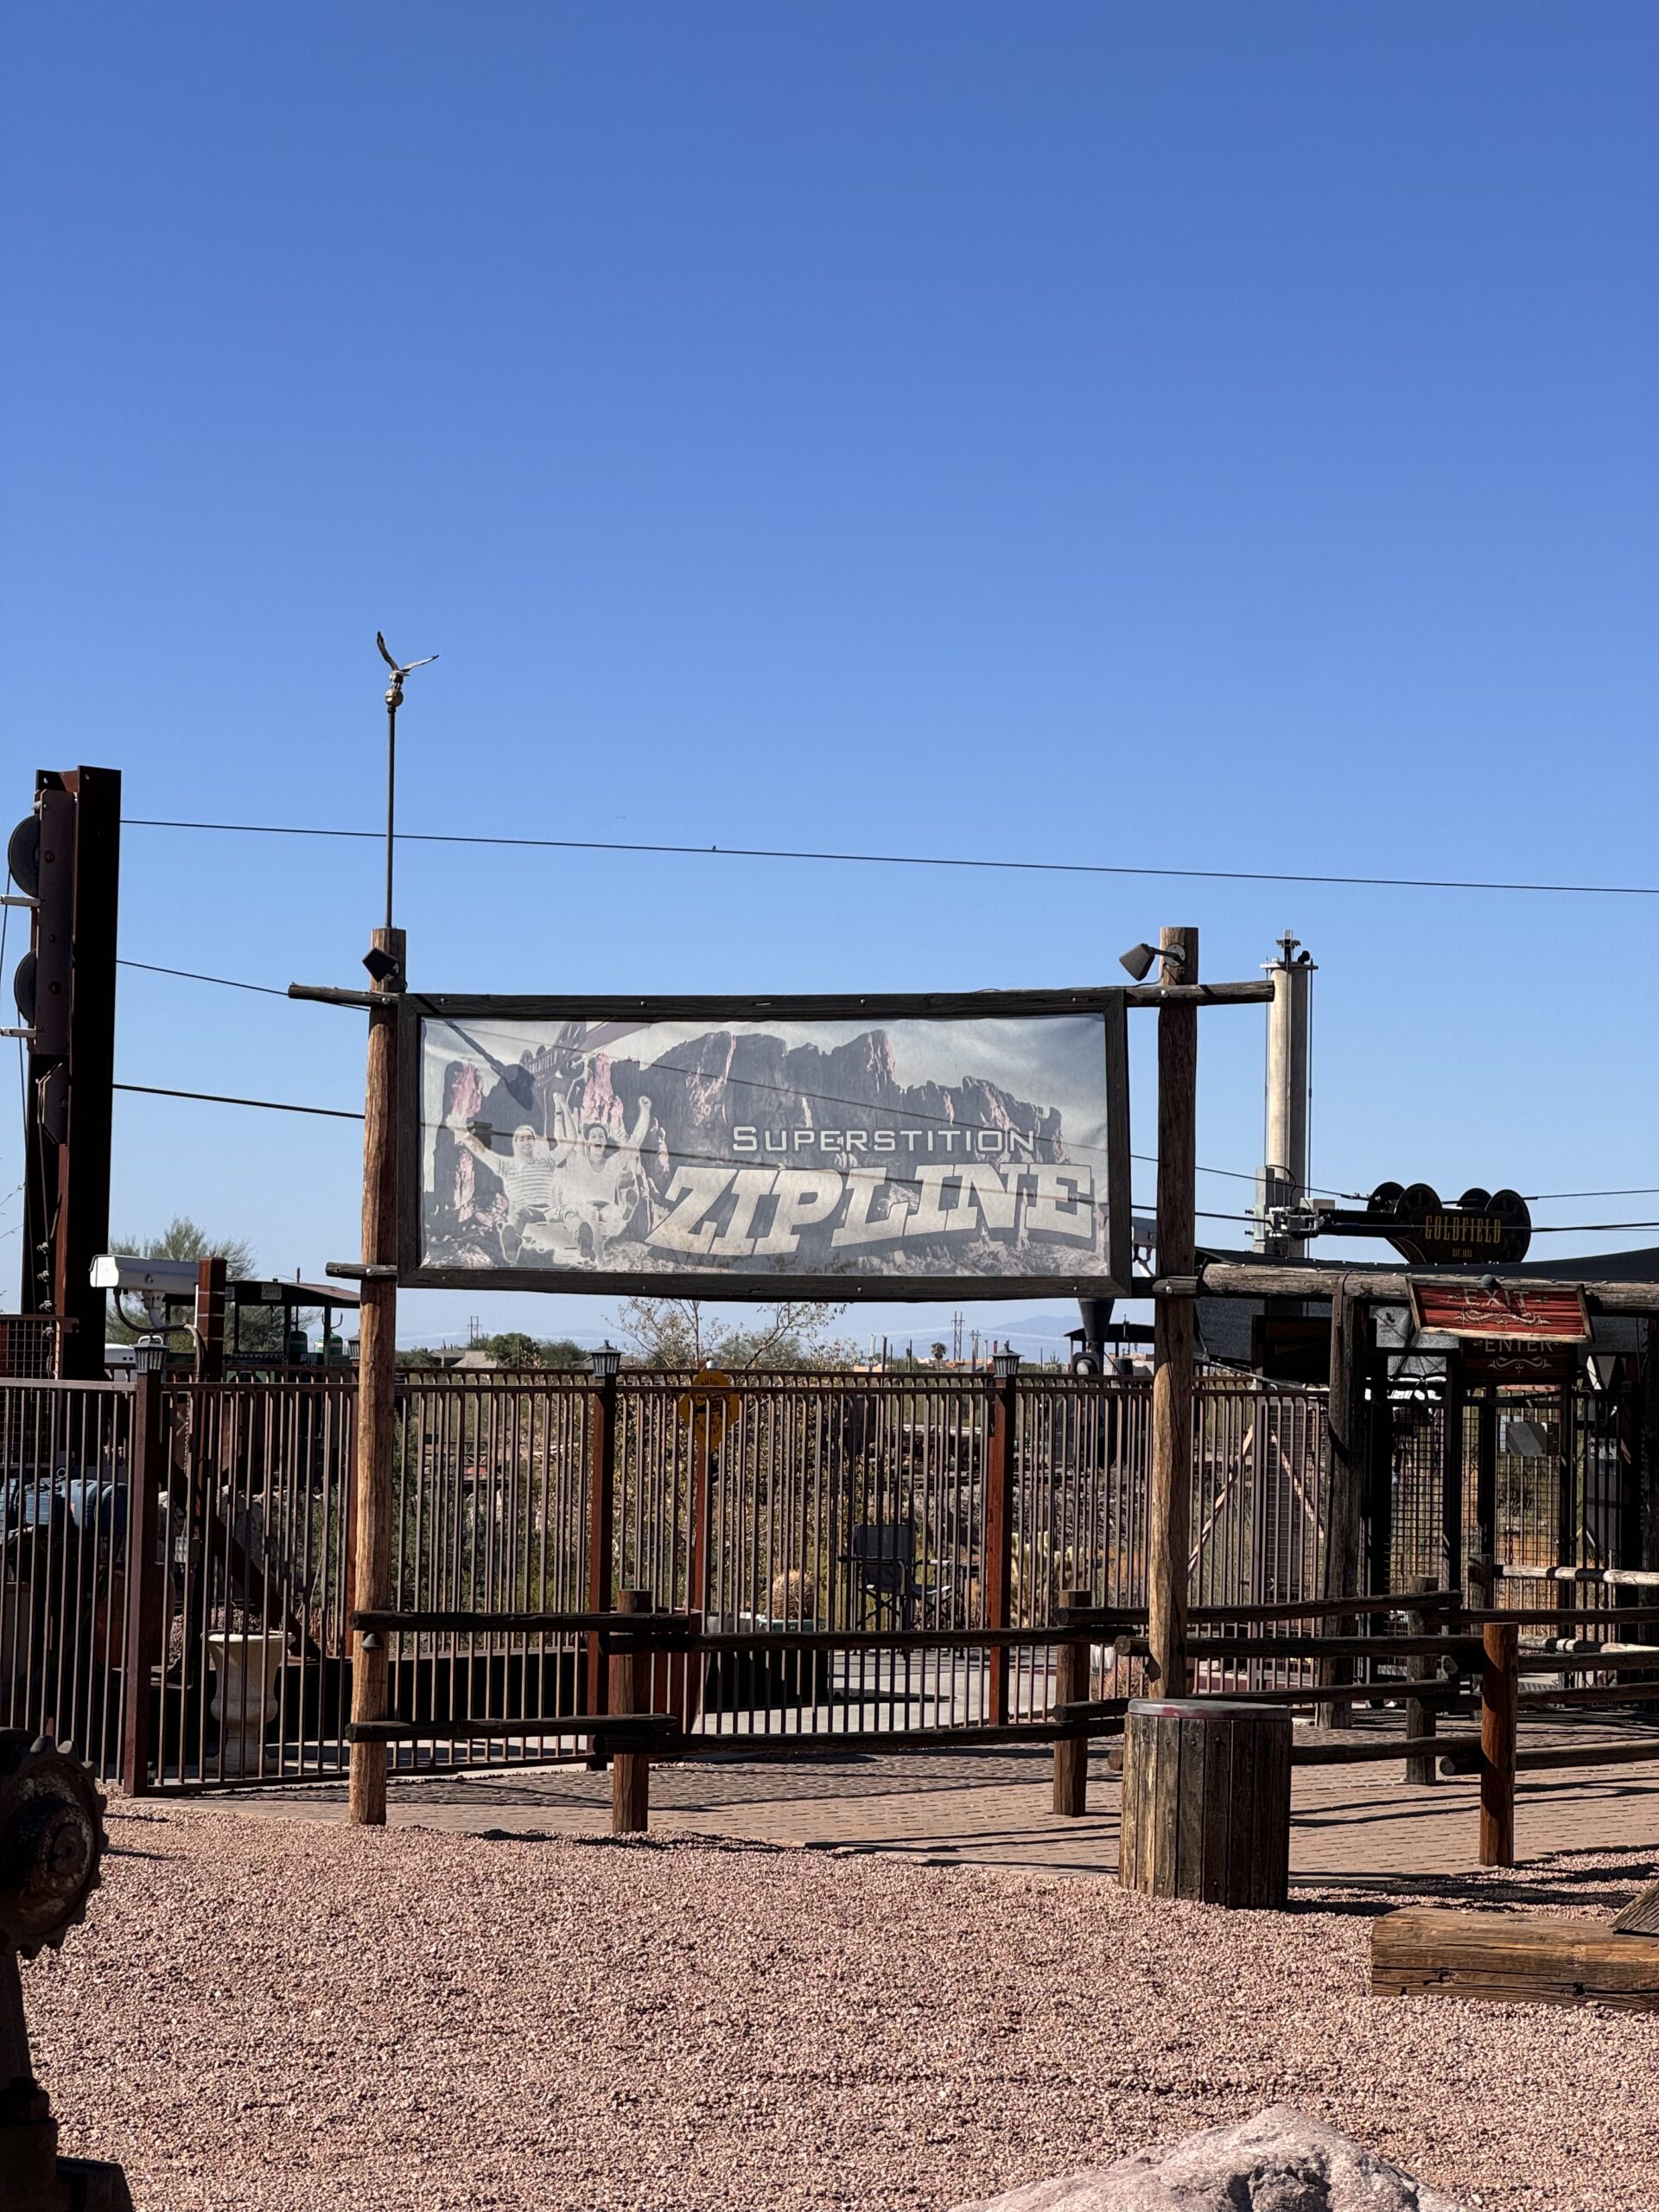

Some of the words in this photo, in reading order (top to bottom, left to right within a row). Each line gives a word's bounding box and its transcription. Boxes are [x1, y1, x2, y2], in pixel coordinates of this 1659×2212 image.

[733, 1126, 1034, 1151] SUPERSTITION
[648, 1163, 1092, 1255] ZIPLINE
[1425, 1215, 1501, 1243] GOLDFIELD
[1463, 1288, 1529, 1309] EXIT
[1484, 1338, 1554, 1352] ENTER
